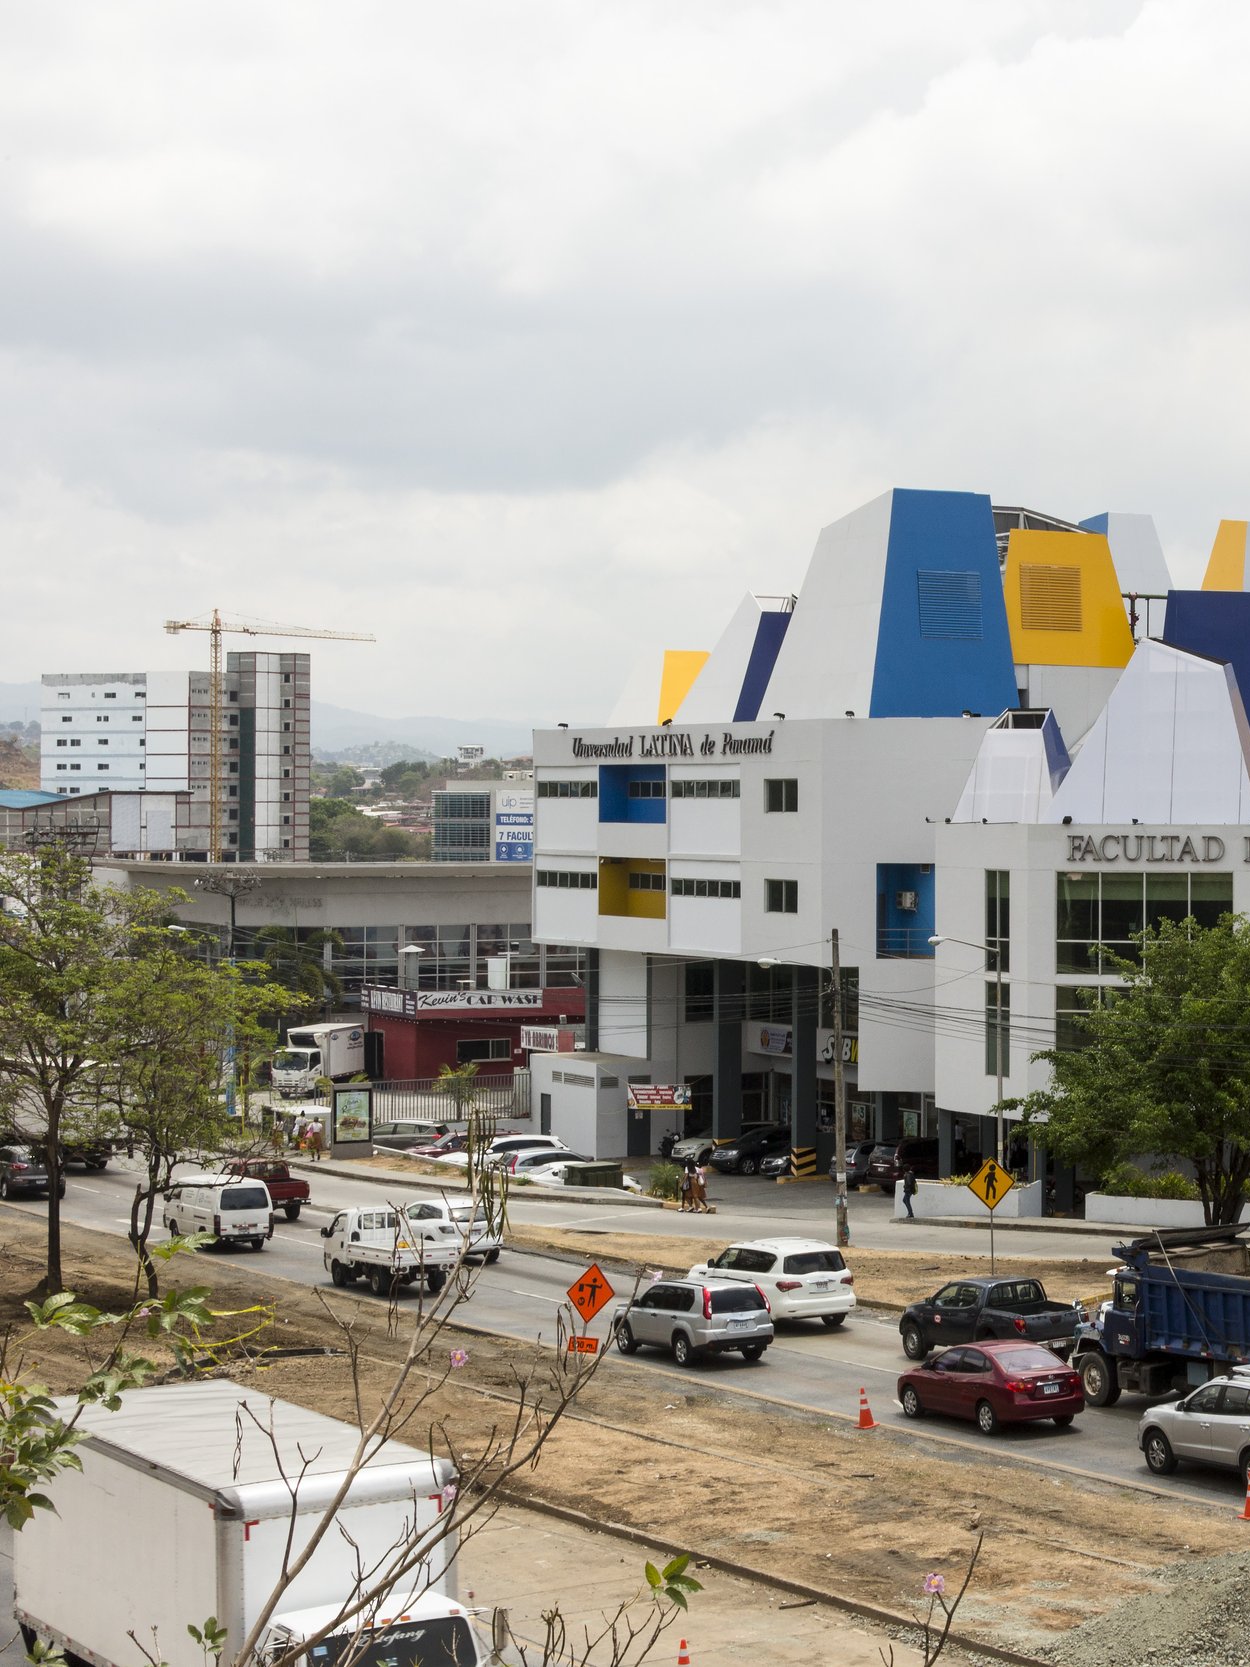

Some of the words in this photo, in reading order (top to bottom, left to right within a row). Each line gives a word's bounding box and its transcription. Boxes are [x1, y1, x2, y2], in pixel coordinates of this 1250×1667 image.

[638, 733, 695, 758] LATINA
[700, 733, 716, 756] de
[720, 730, 775, 755] Panamá
[498, 831, 504, 841] 7
[1066, 834, 1226, 863] FACULTAD
[418, 991, 467, 1009] Kevin's
[465, 994, 497, 1006] CAR
